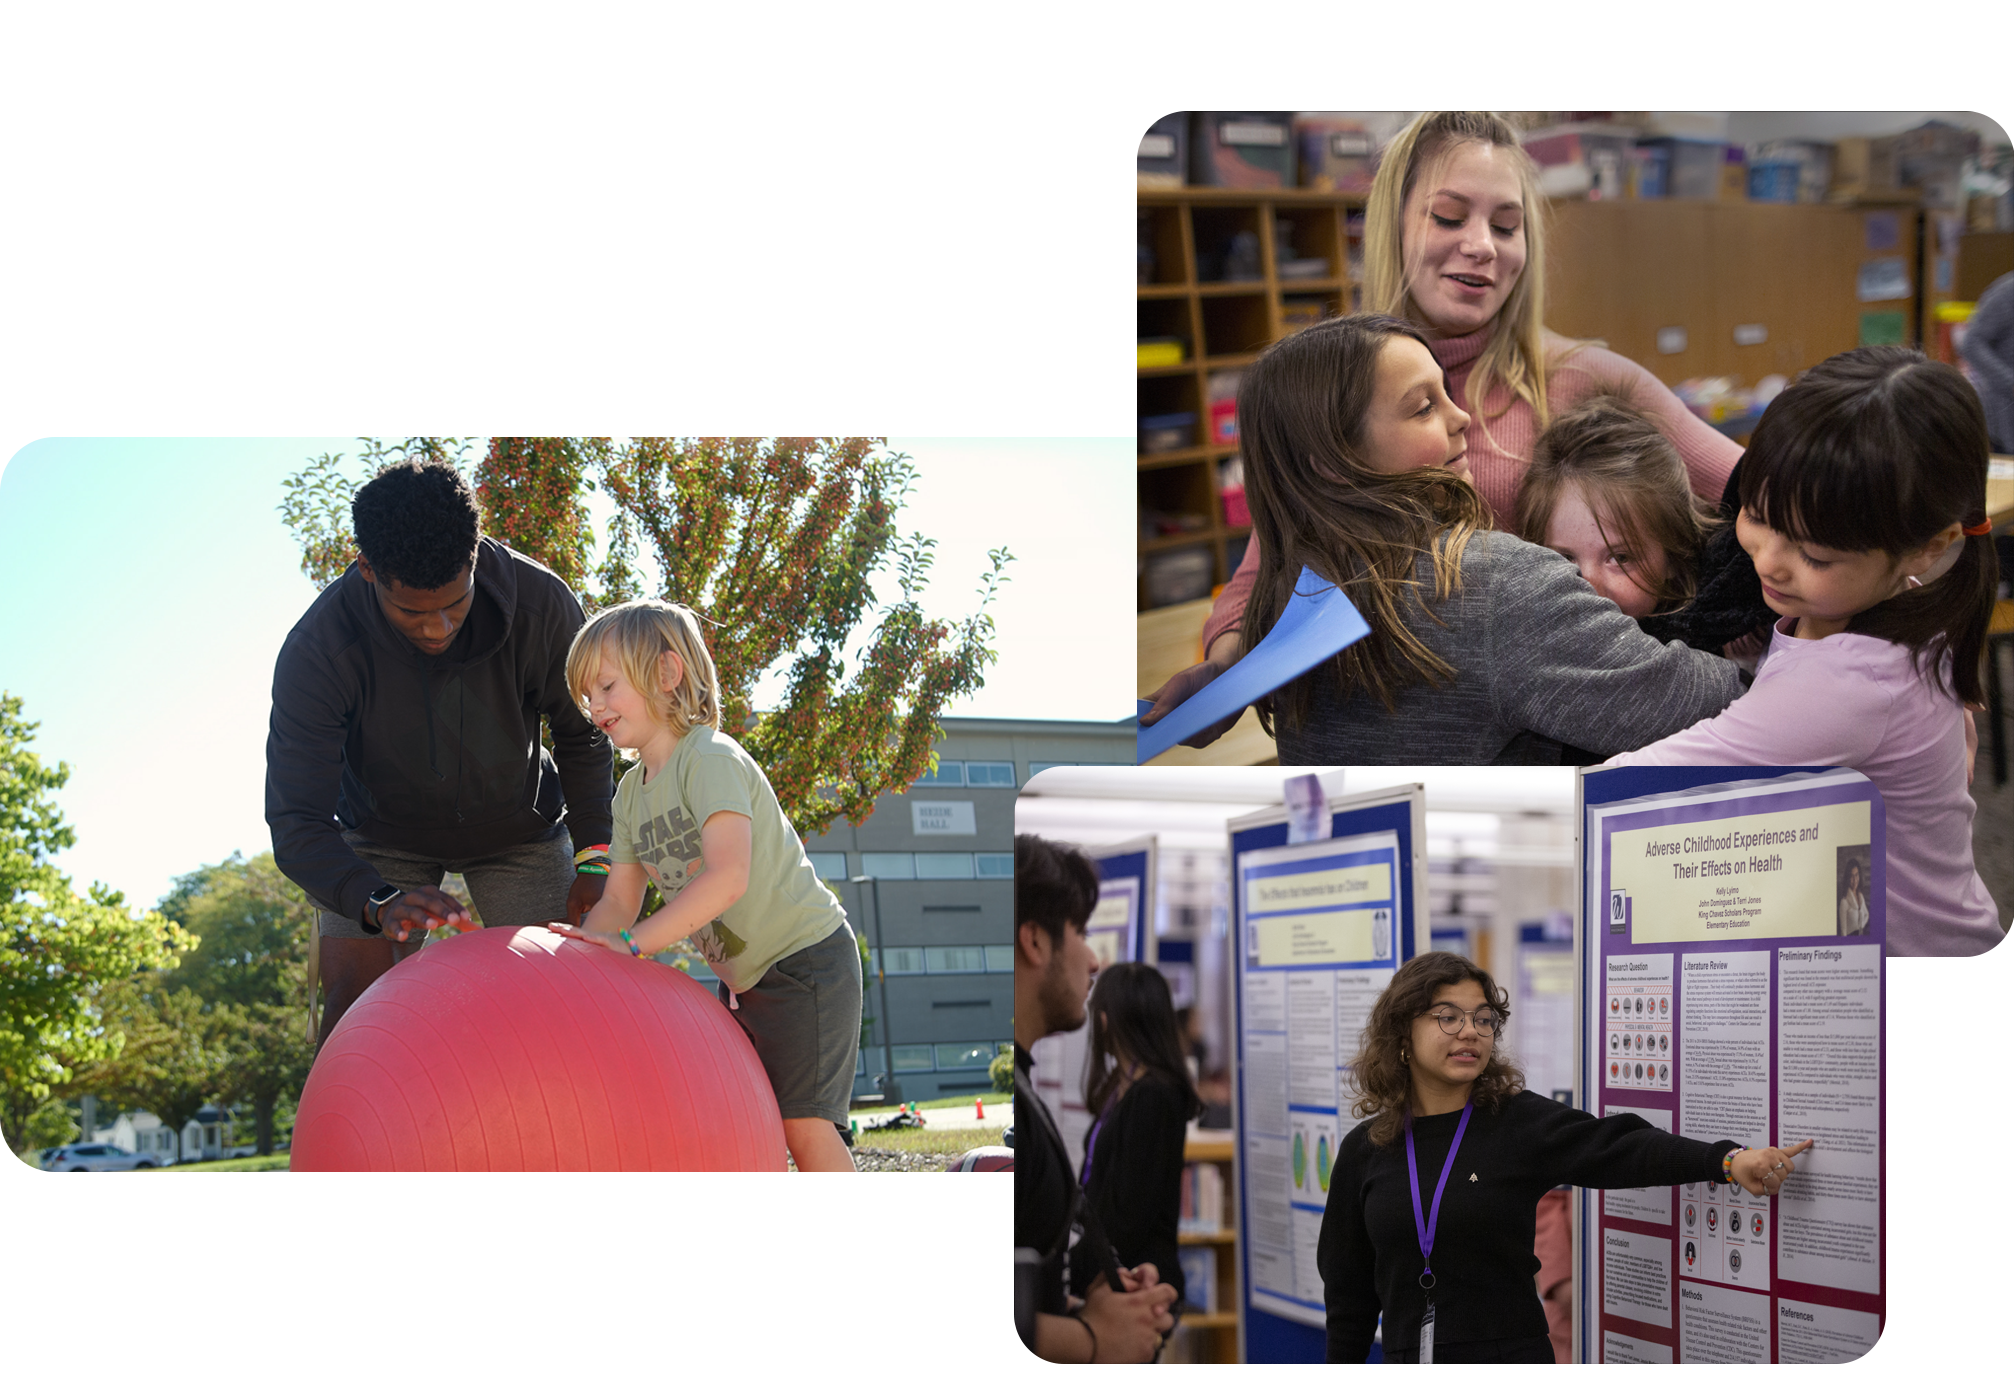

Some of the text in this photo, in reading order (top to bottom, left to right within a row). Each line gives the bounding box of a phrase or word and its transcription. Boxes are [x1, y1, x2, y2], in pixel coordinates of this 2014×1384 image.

[633, 806, 695, 853] STAR
[920, 819, 950, 830] HALL
[1645, 822, 1819, 857] Adverse Childhood Experiences and
[640, 829, 702, 865] WARS
[1673, 854, 1782, 879] Their Effects on Health
[1716, 887, 1726, 896] Kelly
[1698, 899, 1710, 907] John
[1710, 899, 1732, 908] Dominguez
[1737, 897, 1747, 905] Terri
[1747, 896, 1761, 904] Jones
[1698, 908, 1761, 920] King Chavez Scholars Program
[1706, 919, 1750, 930] Elementary Education
[1779, 949, 1842, 962] Preliminary Findings
[1608, 962, 1648, 971] Research Question
[1684, 960, 1728, 971] Literature Review
[1606, 1235, 1629, 1248] Conclusion
[1682, 1288, 1702, 1301] Methods
[1781, 1306, 1814, 1322] References
